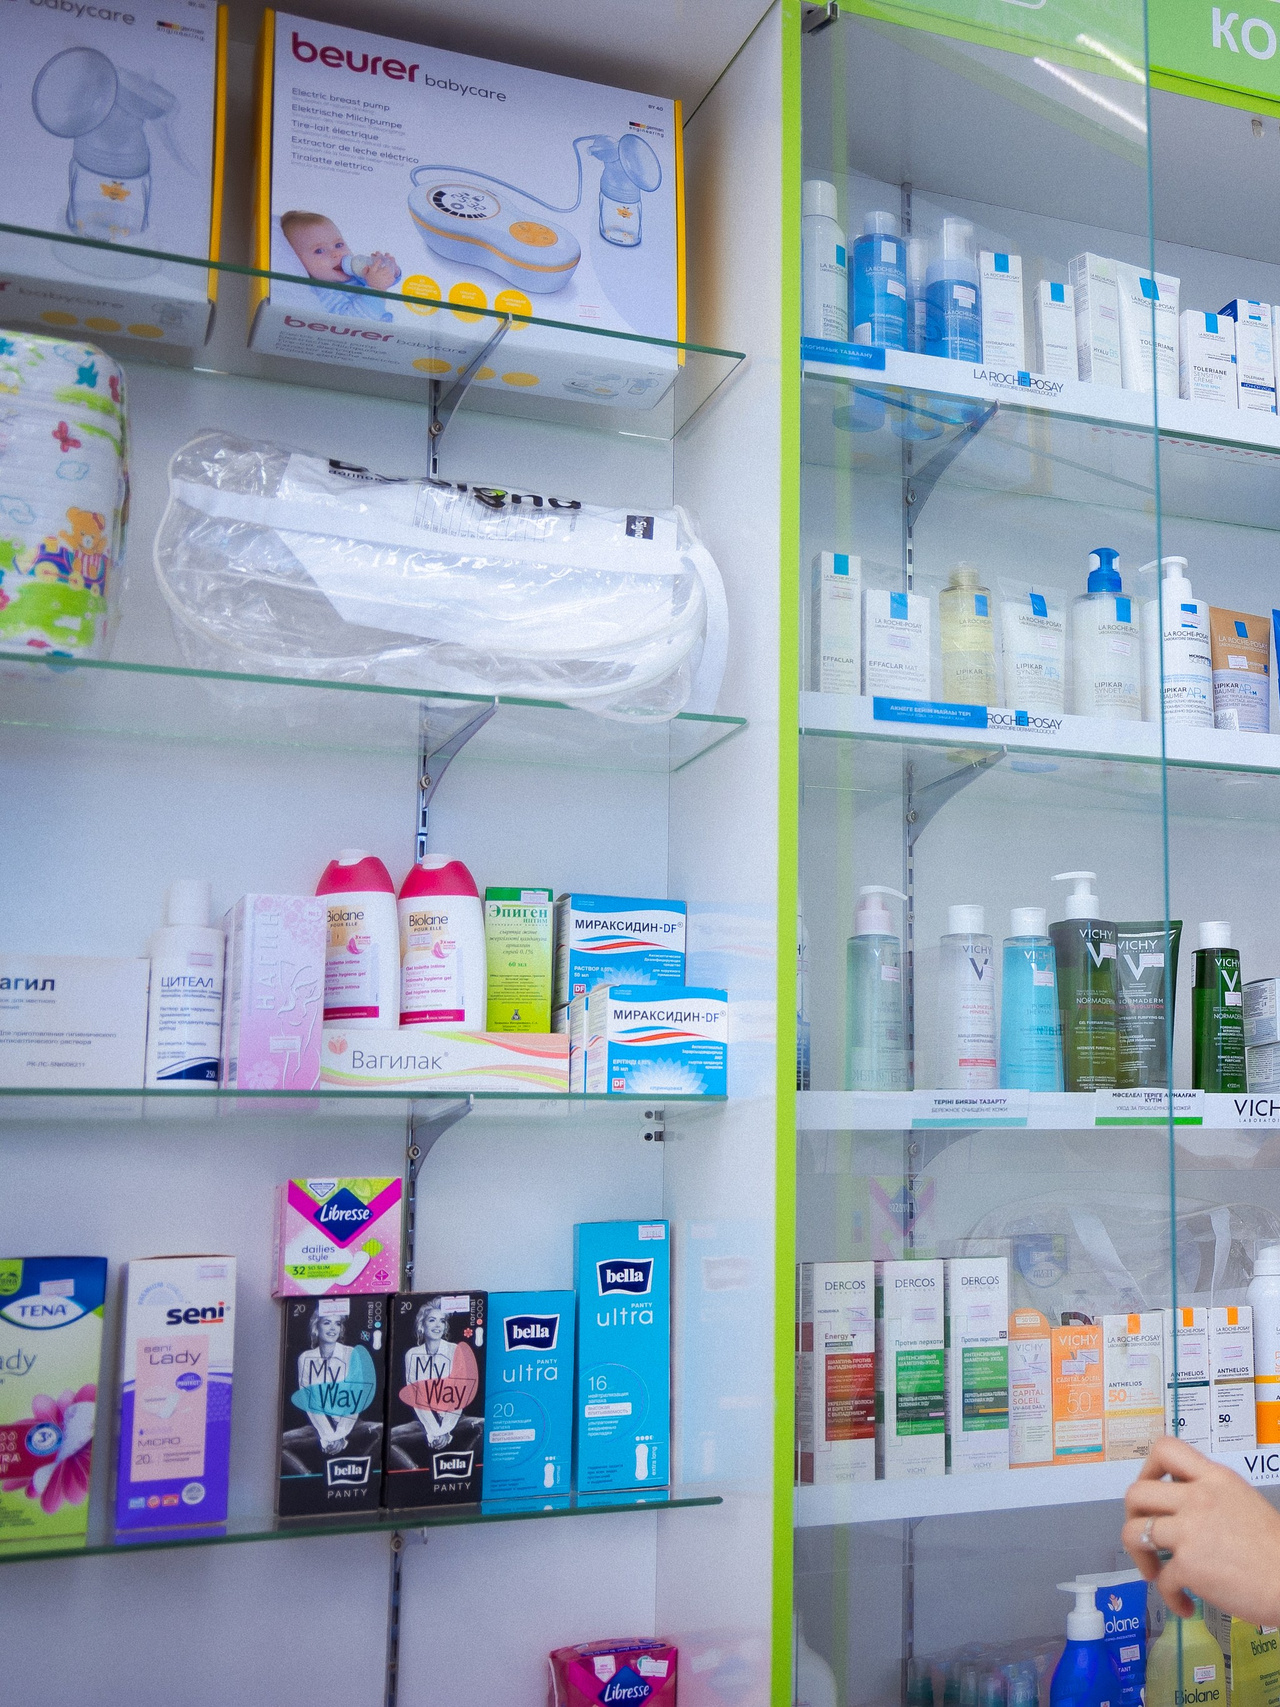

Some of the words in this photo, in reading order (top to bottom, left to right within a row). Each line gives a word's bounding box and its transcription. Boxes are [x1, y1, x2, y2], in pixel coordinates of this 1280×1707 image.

[291, 31, 420, 82] beurer
[425, 74, 507, 102] babycare
[292, 88, 327, 100] Electric
[329, 95, 360, 106] breast
[363, 101, 390, 112] pump
[292, 104, 344, 119] Elektrische
[346, 113, 402, 130] Milchpumpe
[292, 120, 330, 133] Tire-lait
[332, 126, 379, 141] électrique
[292, 135, 336, 150] Extractor
[338, 143, 350, 151] de
[352, 147, 377, 157] leche
[380, 150, 419, 164] eléctrico
[291, 152, 332, 165] Tiralatte
[334, 159, 374, 172] elettrico
[284, 315, 394, 342] beurer
[1194, 366, 1227, 375] TOLERIANE
[974, 369, 988, 379] LA
[989, 372, 1030, 387] ROCHE
[1030, 378, 1064, 393] POSAY
[869, 661, 903, 669] EFFACLAR
[1028, 719, 1062, 730] POSAY
[489, 905, 548, 918] Эпиген
[409, 915, 448, 927] Biolane
[1080, 929, 1112, 940] VICHY
[963, 945, 992, 954] VICHY
[1118, 940, 1158, 950] VICHY
[161, 977, 213, 989] ЦИТЕАЛ
[575, 985, 585, 993] DF
[352, 1051, 443, 1070] Вагилак
[206, 1070, 216, 1078] 250
[320, 1204, 370, 1222] Libresse
[302, 1245, 335, 1254] dailies
[308, 1254, 328, 1262] style
[292, 1266, 305, 1275] 32
[606, 1269, 643, 1283] bella
[825, 1281, 865, 1291] DERCOS
[895, 1279, 935, 1288] DERCOS
[961, 1276, 999, 1285] DERCOS
[19, 1303, 67, 1317] TENA
[294, 1305, 305, 1313] 20
[401, 1302, 412, 1310] 20
[166, 1302, 225, 1325] seni
[597, 1308, 653, 1326] ultra
[513, 1325, 549, 1339] bella
[1059, 1335, 1098, 1346] VICHY
[1118, 1335, 1160, 1343] ROCHE-POSAY
[144, 1345, 171, 1353] seni
[1016, 1344, 1043, 1352] VICHY
[150, 1351, 201, 1366] Lady
[309, 1360, 341, 1390] My
[416, 1356, 445, 1386] My
[503, 1364, 558, 1382] ultra
[588, 1376, 607, 1391] 16
[319, 1383, 363, 1414] Way
[425, 1379, 467, 1410] Way
[1066, 1391, 1091, 1414] 50
[493, 1403, 514, 1418] 20
[138, 1437, 180, 1447] MICRO
[135, 1454, 150, 1465] 20
[440, 1458, 466, 1469] bella
[334, 1466, 362, 1475] bella
[328, 1489, 367, 1498] PANTY
[434, 1483, 471, 1492] PANTY
[1251, 1638, 1278, 1656] Biolane
[604, 1684, 650, 1702] Libresse
[1175, 1688, 1220, 1705] Biolane
